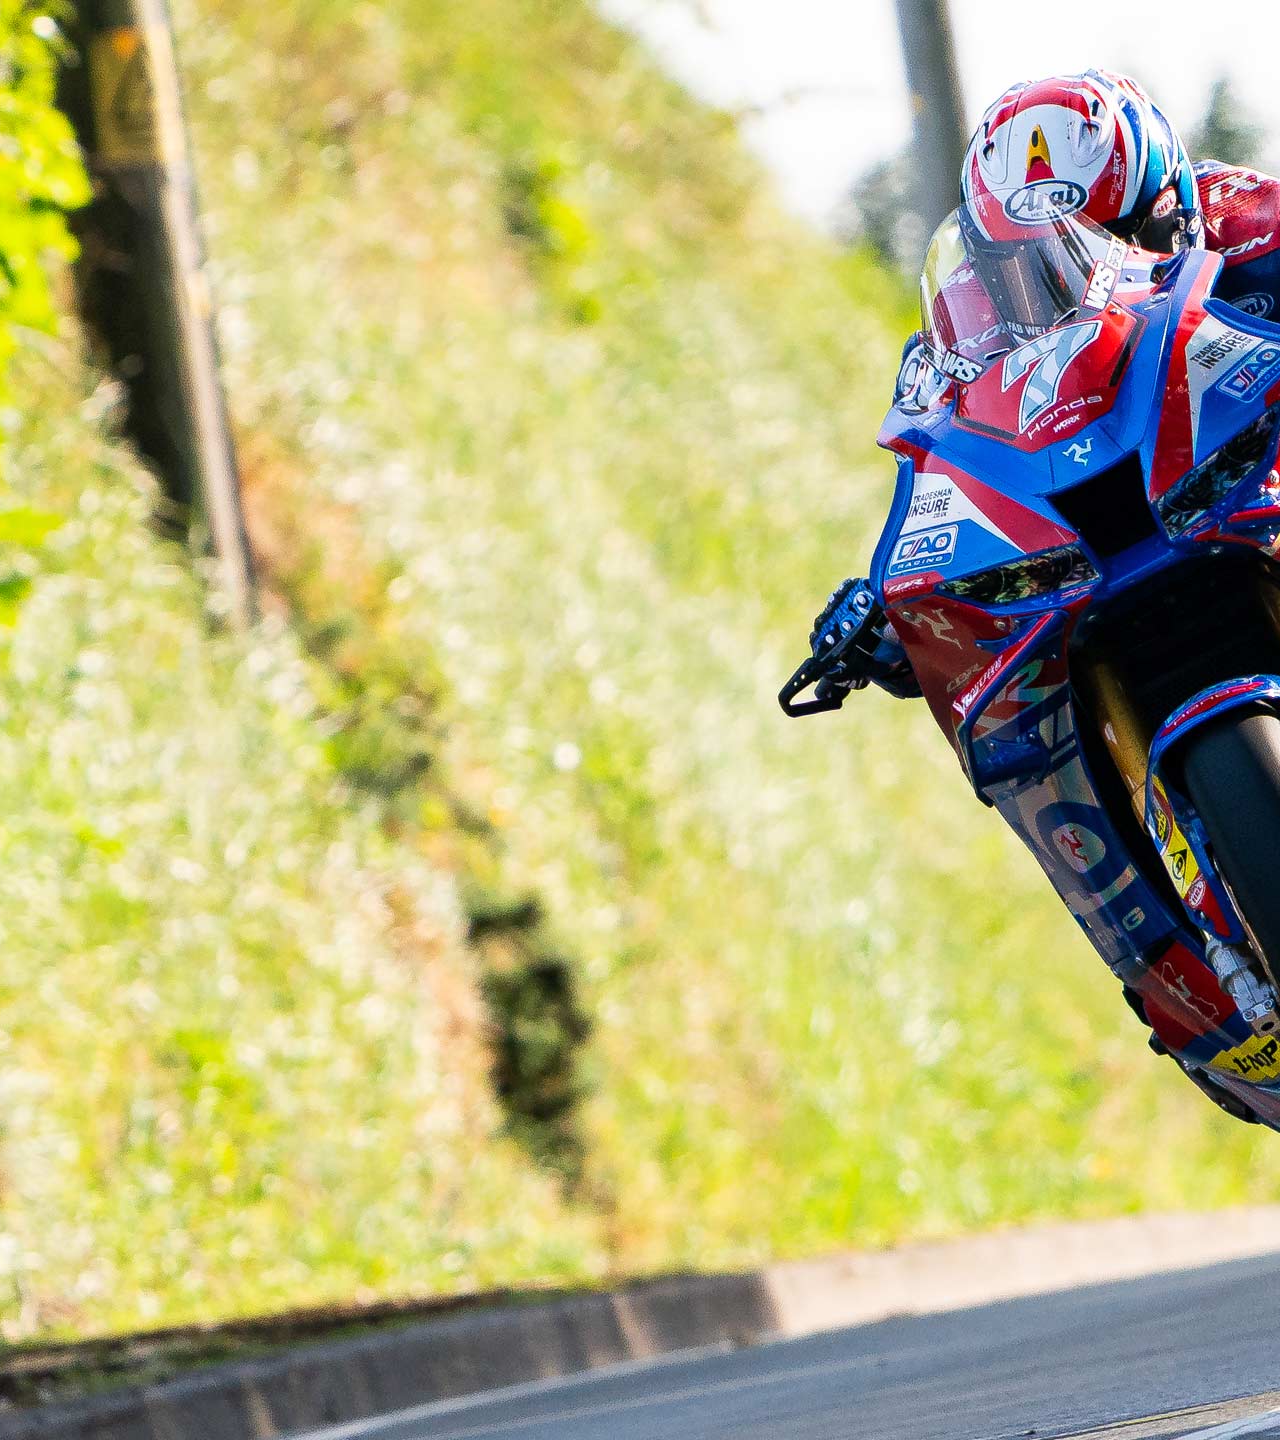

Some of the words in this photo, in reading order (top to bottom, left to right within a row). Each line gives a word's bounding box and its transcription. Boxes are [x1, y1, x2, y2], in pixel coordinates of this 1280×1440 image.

[1011, 184, 1077, 212] Arai
[1084, 261, 1116, 310] WRS
[1189, 330, 1235, 362] TRADESMAN
[1199, 334, 1248, 369] INSURE
[942, 351, 983, 383] WRS
[1001, 320, 1103, 434] 7
[1027, 395, 1103, 440] Honda
[908, 497, 951, 518] INSURE
[913, 487, 953, 504] TRADESMAN
[897, 556, 943, 569] RACING
